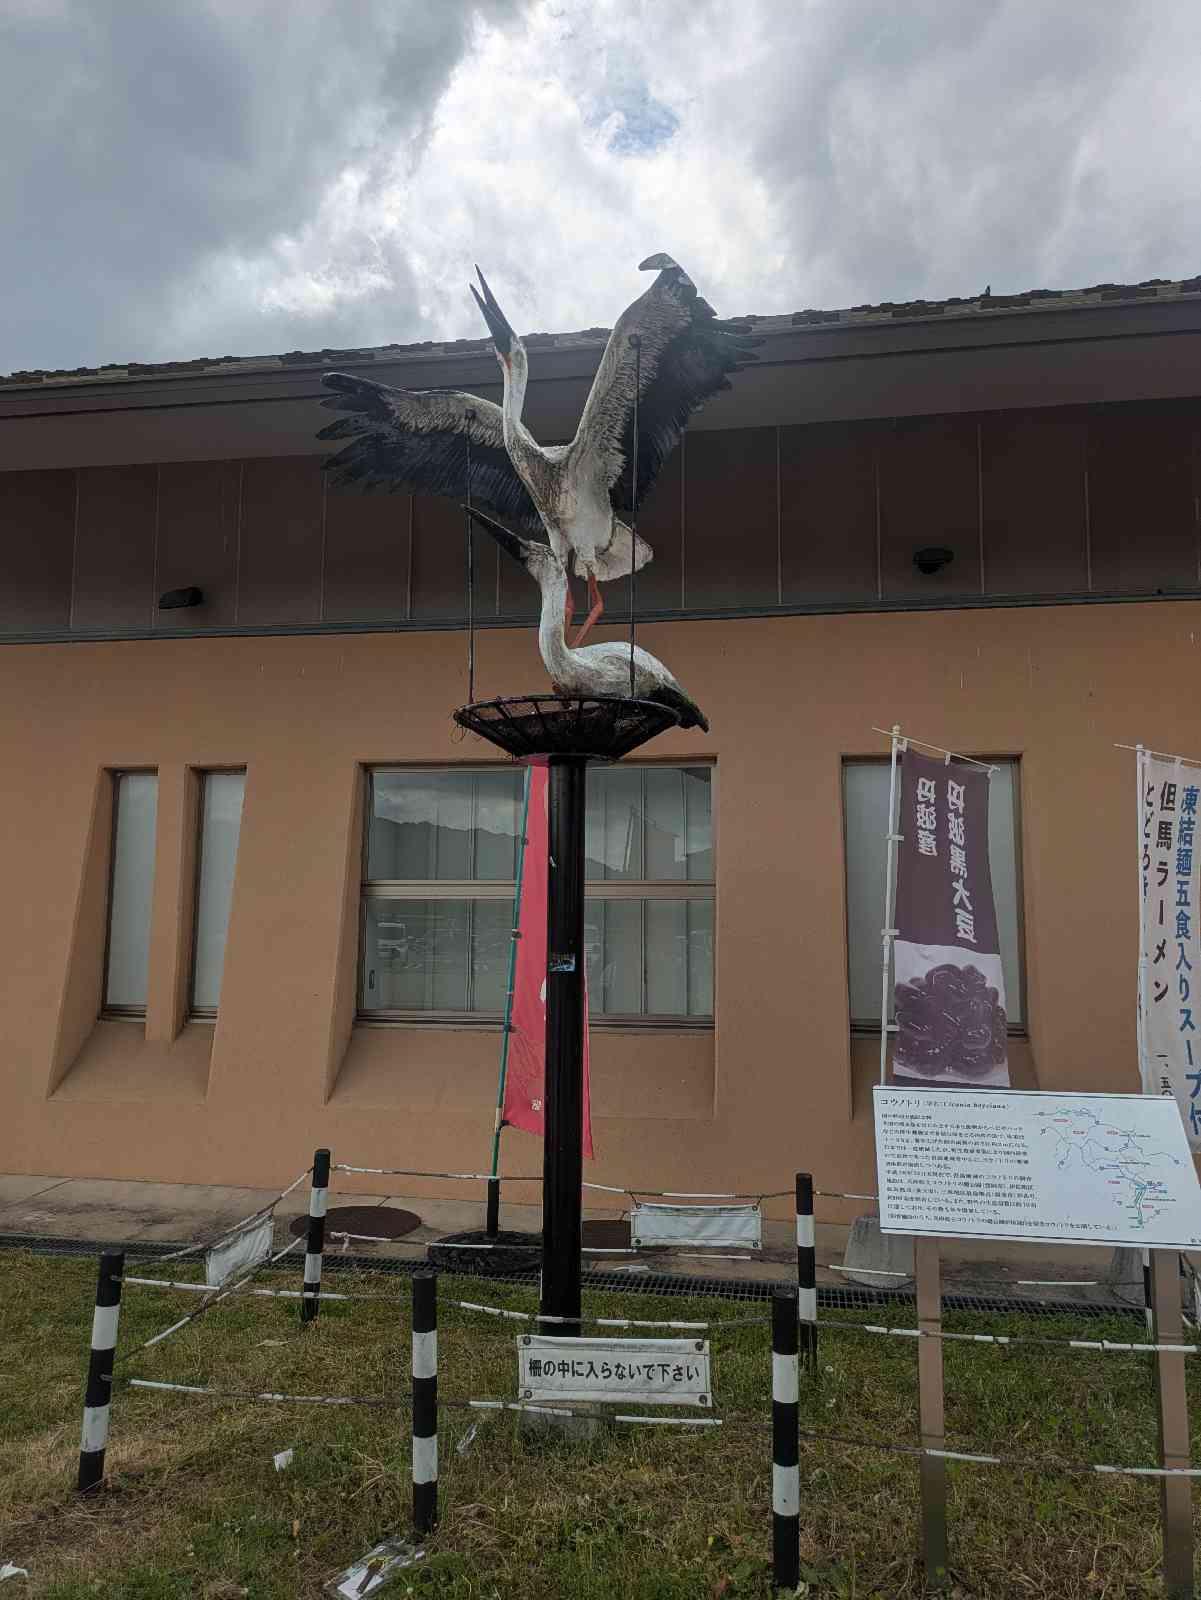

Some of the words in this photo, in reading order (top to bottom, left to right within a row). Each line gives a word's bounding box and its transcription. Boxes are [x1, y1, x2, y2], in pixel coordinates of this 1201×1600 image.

[1154, 781, 1177, 1002] 但馬ラーメン
[528, 1358, 700, 1382] 柵の中に入らないで下さい
